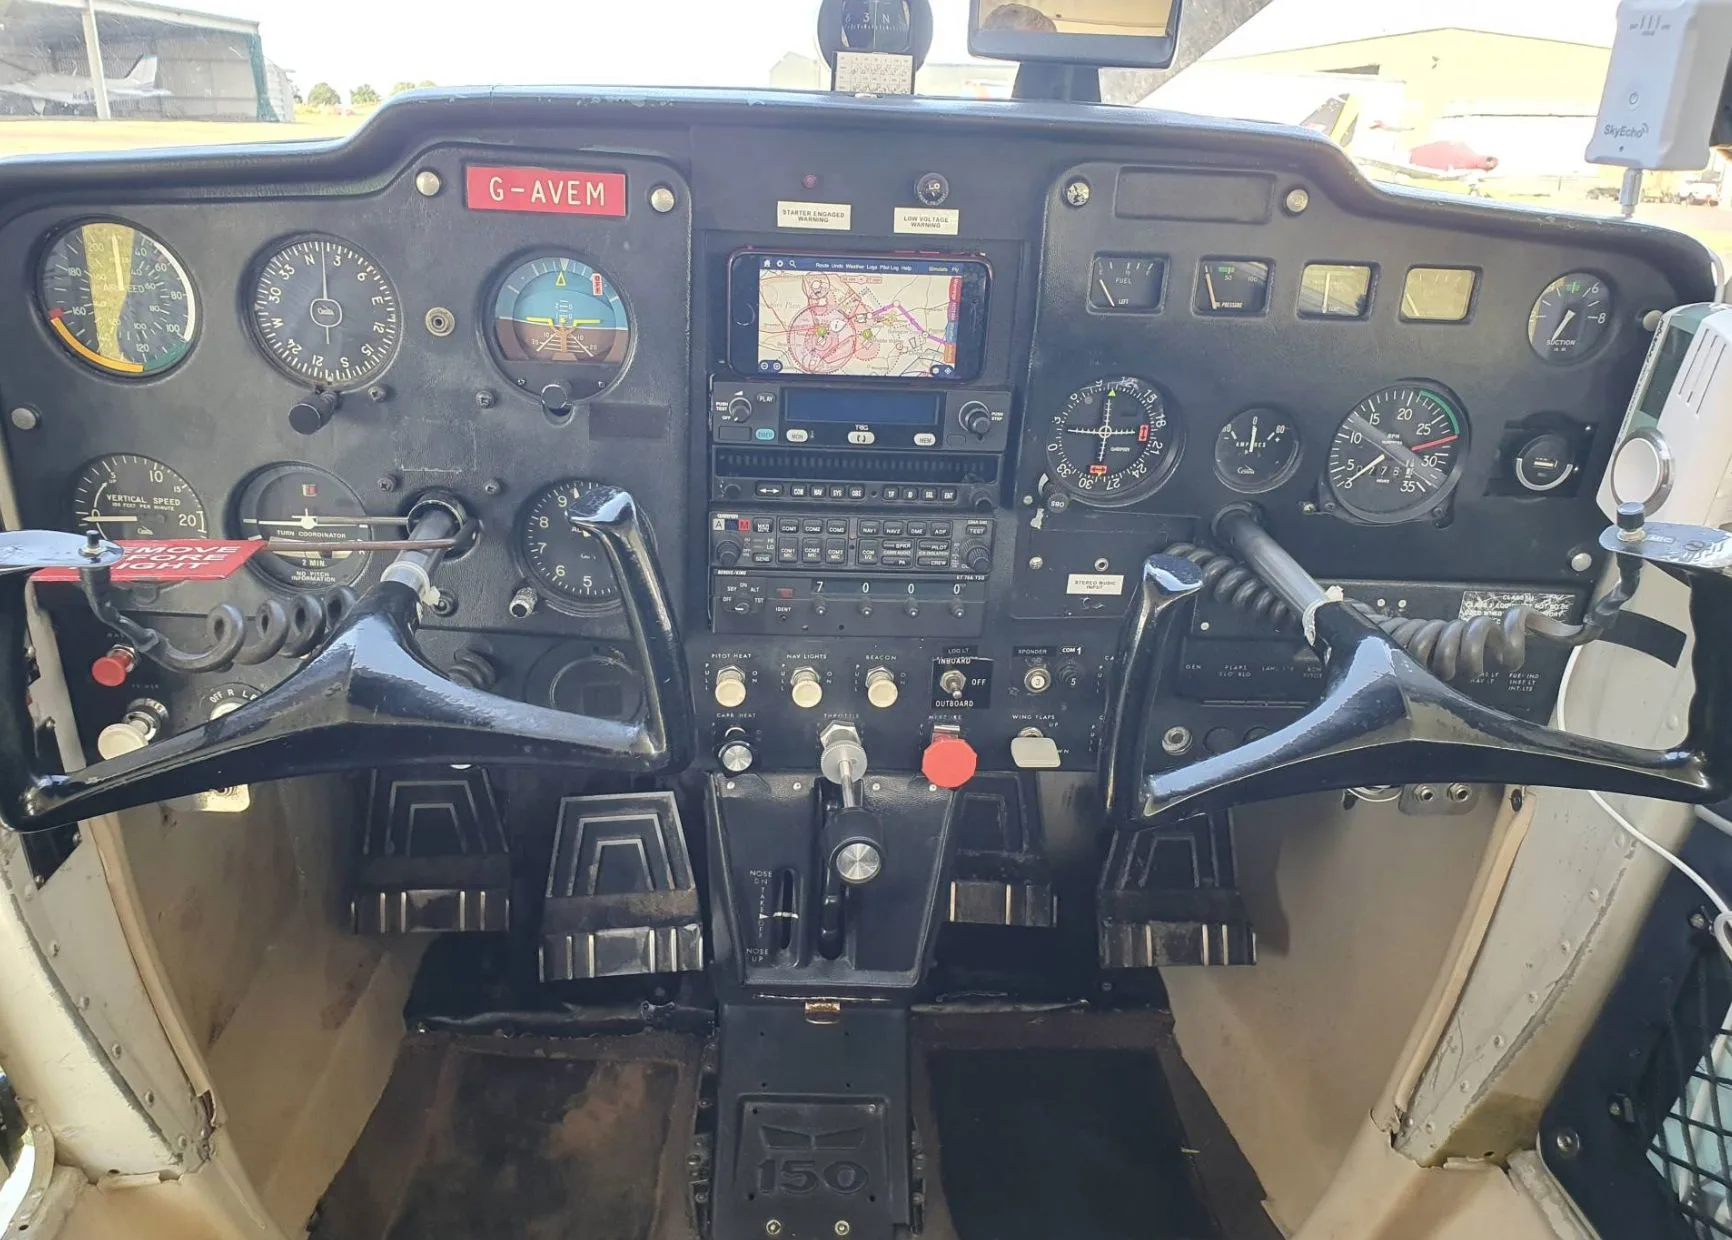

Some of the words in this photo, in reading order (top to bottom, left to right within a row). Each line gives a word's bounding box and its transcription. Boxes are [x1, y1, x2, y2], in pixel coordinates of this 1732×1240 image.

[863, 12, 870, 22] 3
[882, 14, 890, 24] N
[1603, 124, 1643, 139] SkyEcho
[489, 176, 605, 206] G-AVEM
[782, 209, 812, 217] STARTER
[798, 215, 829, 223] WARNING
[910, 221, 941, 229] WARNING
[135, 248, 147, 257] 40
[304, 254, 315, 265] N
[333, 256, 341, 266] 3
[68, 267, 82, 277] 180
[155, 264, 168, 272] 60
[278, 264, 295, 280] 33
[357, 272, 367, 281] 6
[1592, 282, 1599, 293] 6
[170, 291, 183, 300] 80
[268, 287, 282, 303] 30
[371, 296, 384, 305] E
[72, 307, 87, 316] 160
[1597, 312, 1606, 324] 8
[166, 324, 180, 333] 100
[373, 321, 385, 334] 12
[136, 343, 149, 352] 120
[287, 339, 302, 354] 24
[361, 343, 374, 356] 15
[312, 355, 324, 367] 21
[340, 357, 350, 367] S
[1143, 389, 1158, 403] 15
[1369, 413, 1380, 425] 15
[1397, 408, 1412, 420] 20
[1155, 414, 1166, 428] 18
[1253, 416, 1258, 425] 0
[1416, 423, 1431, 435] 25
[1350, 433, 1362, 444] 10
[1048, 443, 1058, 451] 0
[1150, 441, 1163, 455] 21
[1347, 459, 1354, 470] 5
[1421, 455, 1437, 467] 30
[1057, 464, 1071, 477] 33
[1132, 465, 1147, 478] 24
[150, 471, 163, 483] 10
[1078, 478, 1094, 489] 30
[1106, 478, 1121, 490] 27
[1401, 481, 1415, 492] 35
[793, 487, 804, 496] COM
[813, 488, 823, 496] NAV
[832, 488, 842, 497] SYS
[852, 489, 862, 497] OBS
[944, 492, 953, 500] ENT
[107, 494, 147, 503] VERTICAL
[153, 497, 180, 506] SPEED
[558, 495, 567, 507] 9
[178, 514, 197, 527] 20
[539, 516, 549, 528] 8
[715, 520, 722, 528] A
[739, 520, 749, 529] M
[124, 546, 241, 554] EMOVE
[538, 542, 547, 554] 7
[555, 565, 565, 576] 6
[583, 576, 593, 587] 5
[816, 581, 824, 593] 7
[862, 582, 869, 593] 0
[908, 583, 914, 594] 0
[954, 584, 960, 594] 0
[209, 691, 223, 703] OFF
[242, 690, 249, 698] L
[757, 1158, 869, 1195] 150
